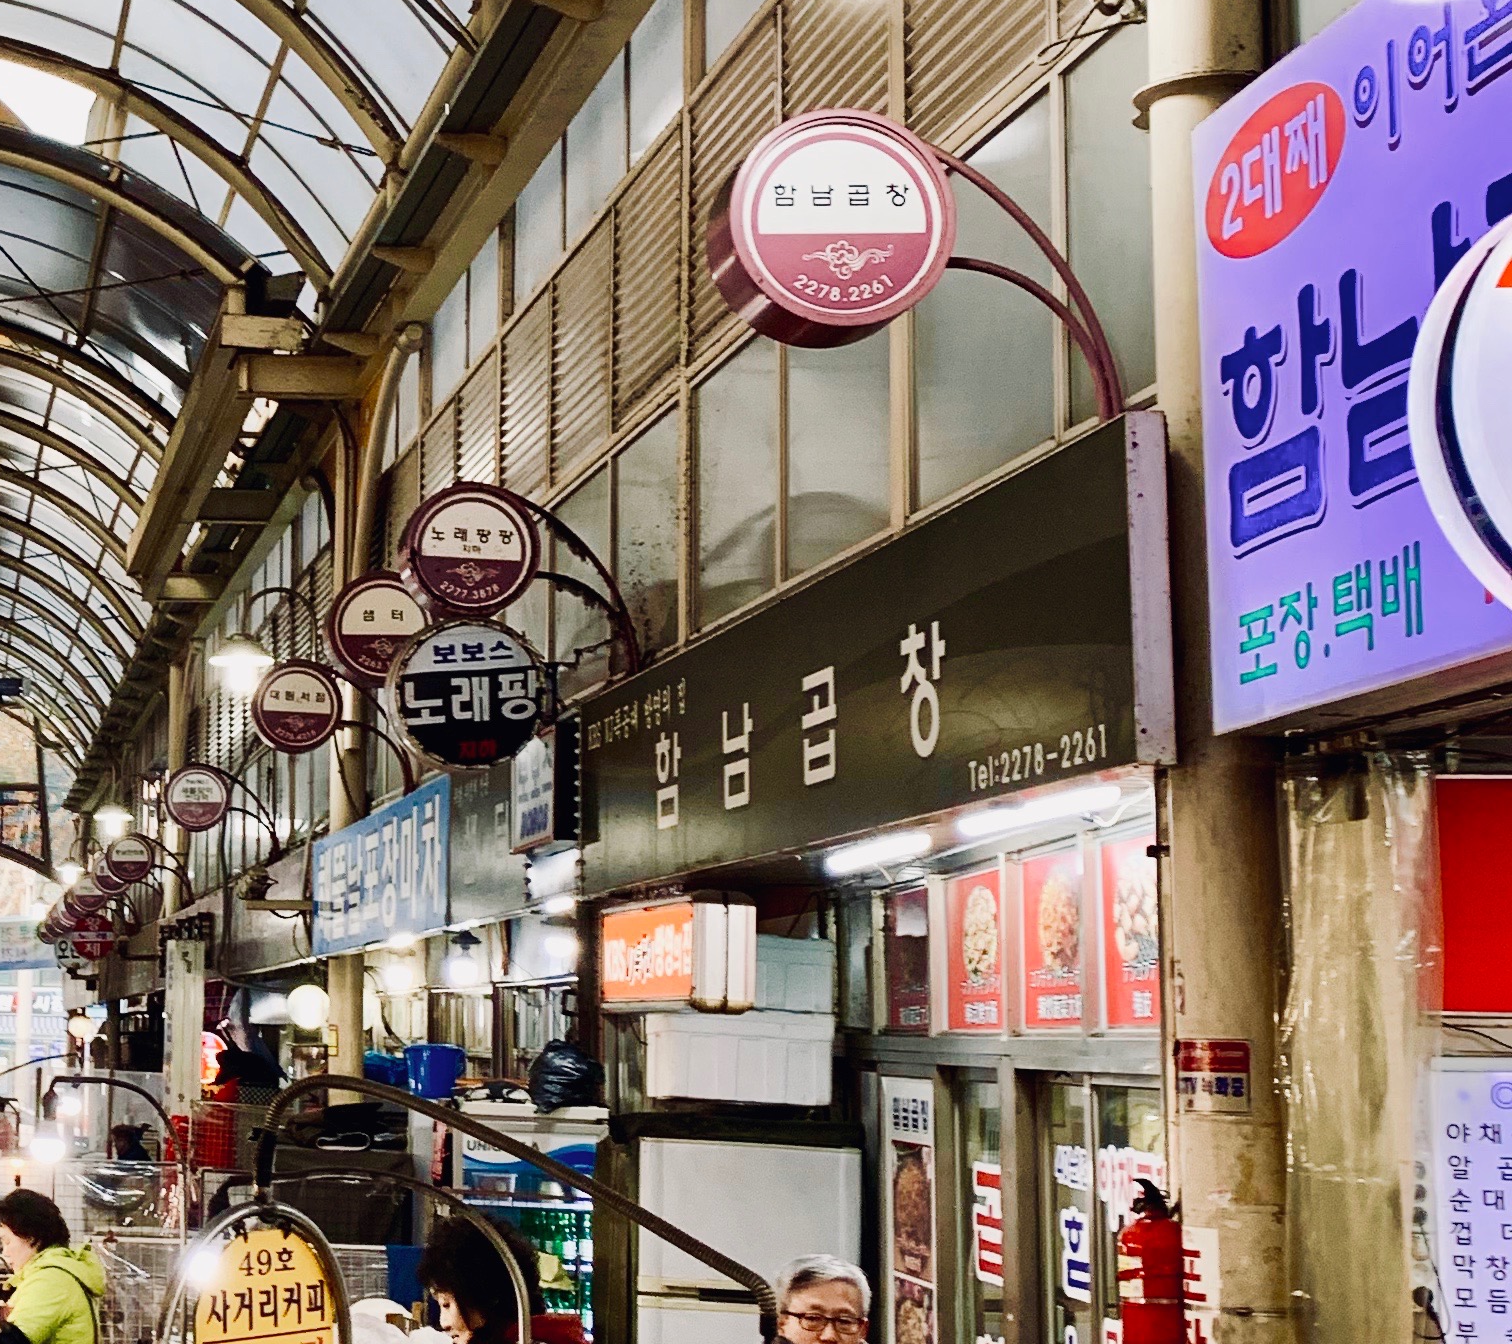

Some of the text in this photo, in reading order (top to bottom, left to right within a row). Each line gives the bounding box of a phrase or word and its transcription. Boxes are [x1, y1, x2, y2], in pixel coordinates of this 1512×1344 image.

[1219, 93, 1328, 240] 2대째
[774, 184, 910, 207] 함남곱창
[792, 273, 895, 302] 2278.2261
[361, 609, 405, 623] 샘터
[432, 640, 514, 664] 보보스
[404, 670, 538, 726] 노래팡
[655, 619, 947, 830] 함남곱창
[968, 724, 1109, 792] Tel:2278-2261
[1449, 1189, 1505, 1213] 순대
[237, 1247, 297, 1278] 49호
[1453, 1253, 1509, 1281] 막창
[206, 1279, 327, 1335] 사거리커피
[1454, 1286, 1510, 1314] 모듬
